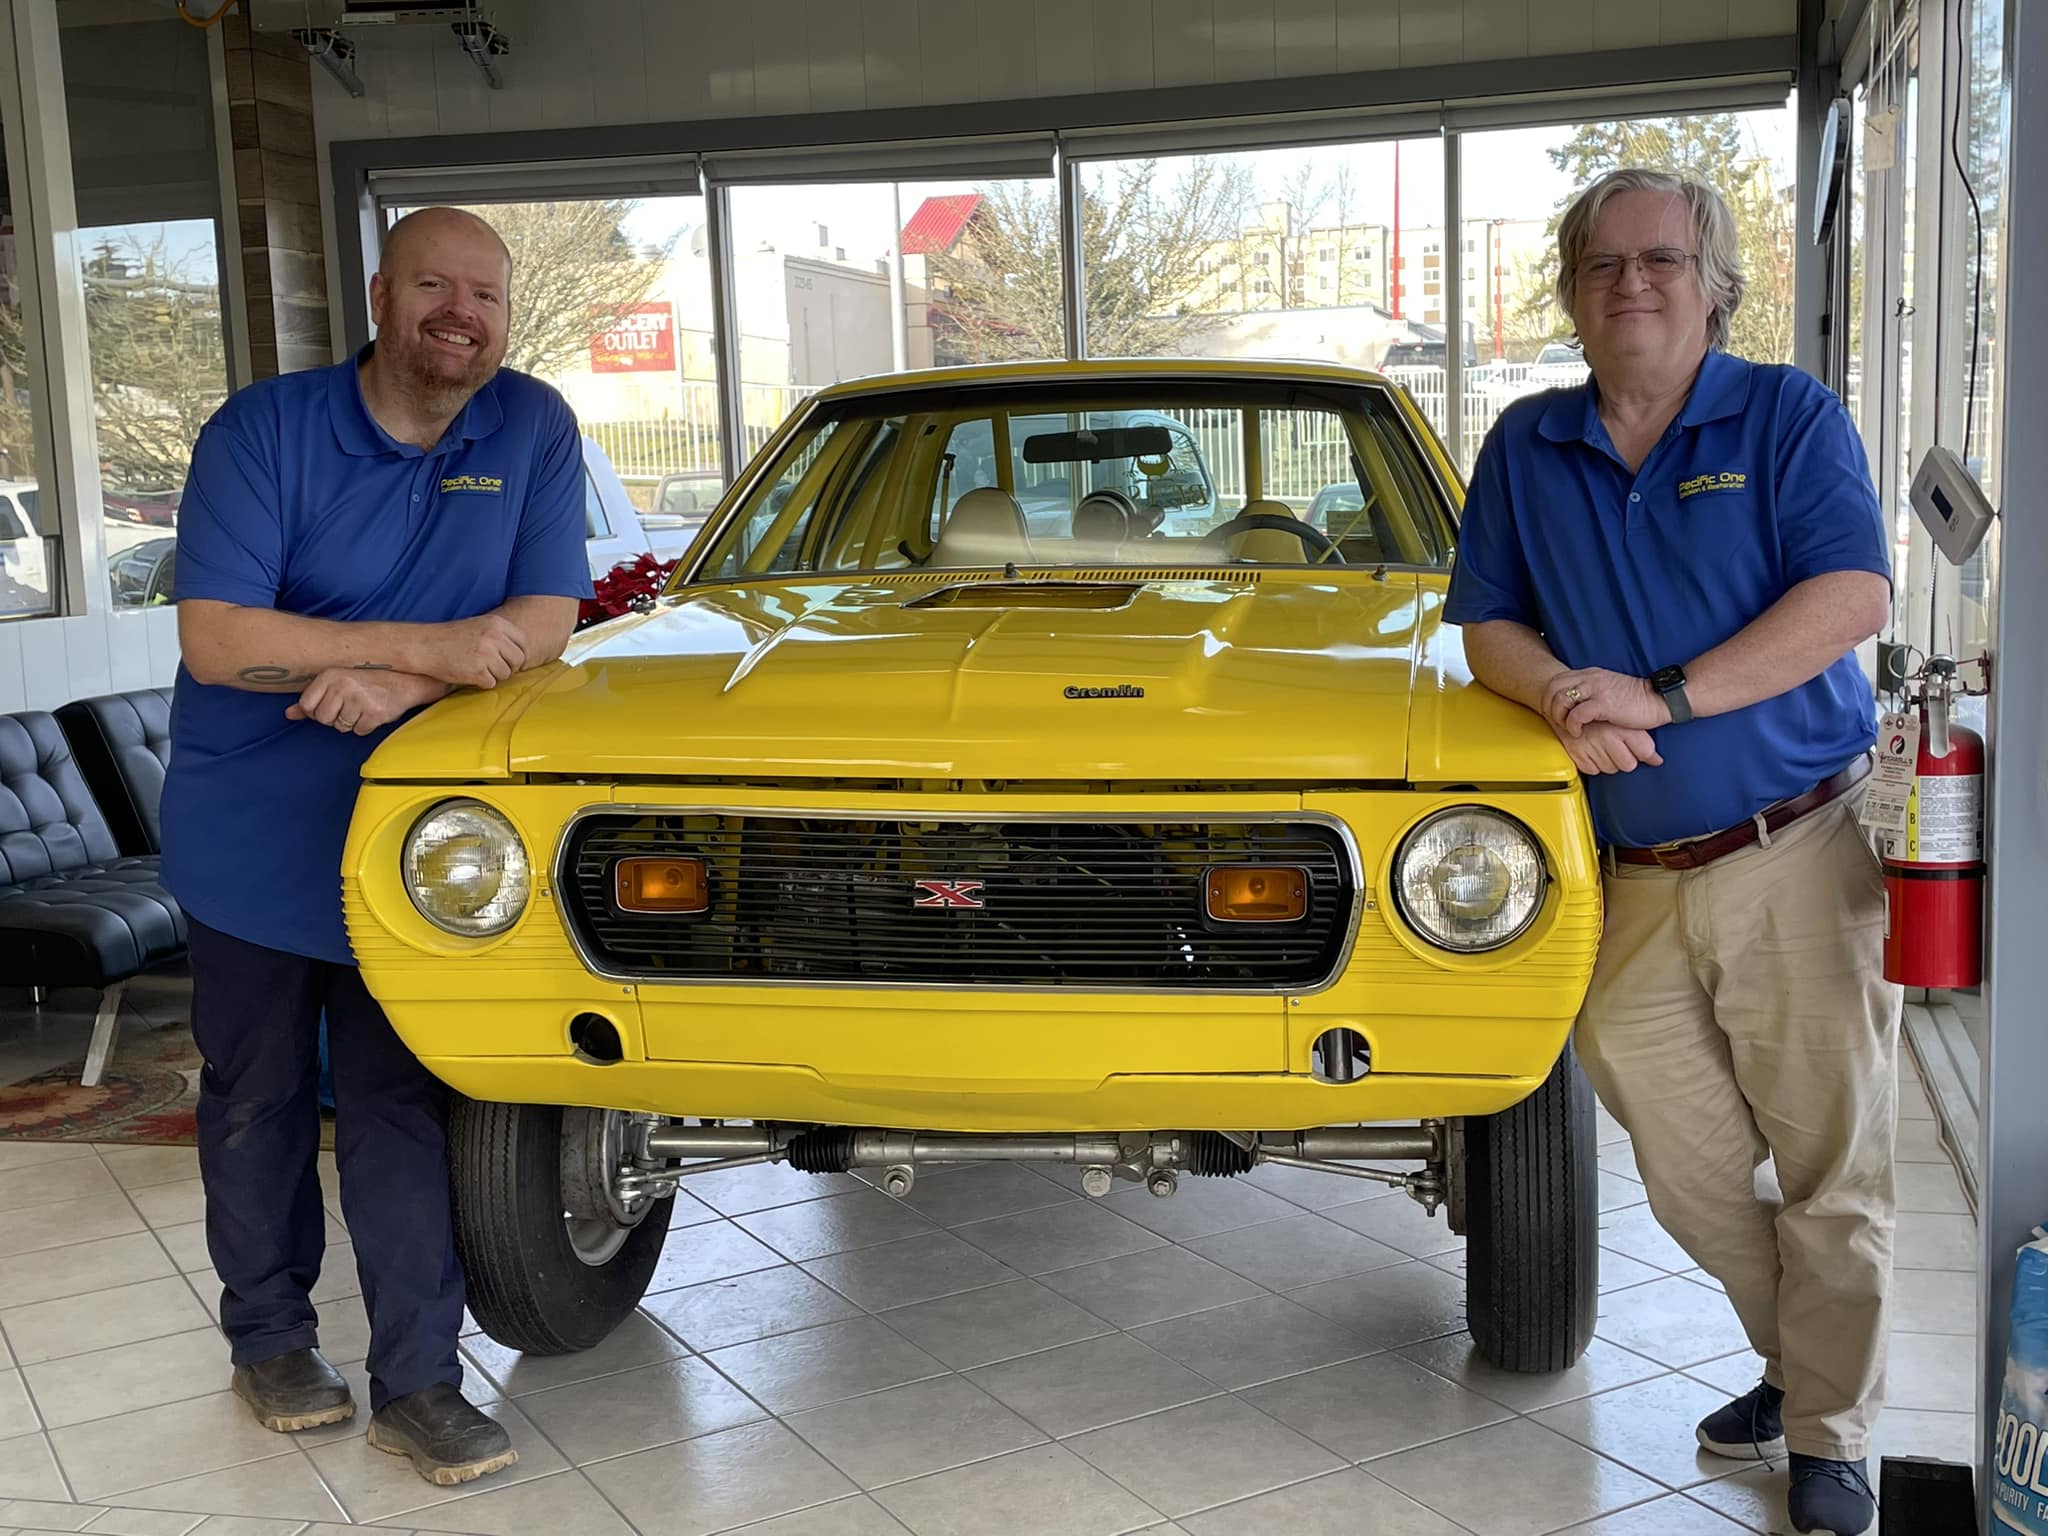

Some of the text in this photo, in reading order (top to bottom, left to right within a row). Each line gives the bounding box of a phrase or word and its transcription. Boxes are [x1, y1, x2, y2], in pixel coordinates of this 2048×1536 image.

[597, 313, 669, 332] OCERY
[605, 331, 658, 351] OUTLET
[479, 476, 502, 486] One
[1679, 472, 1746, 493] Pacific One
[1063, 683, 1144, 699] Gremlin
[1910, 785, 1917, 797] A
[1910, 813, 1917, 825] B
[1910, 840, 1917, 852] C
[915, 879, 984, 908] X
[2001, 1481, 2030, 1512] PURITY
